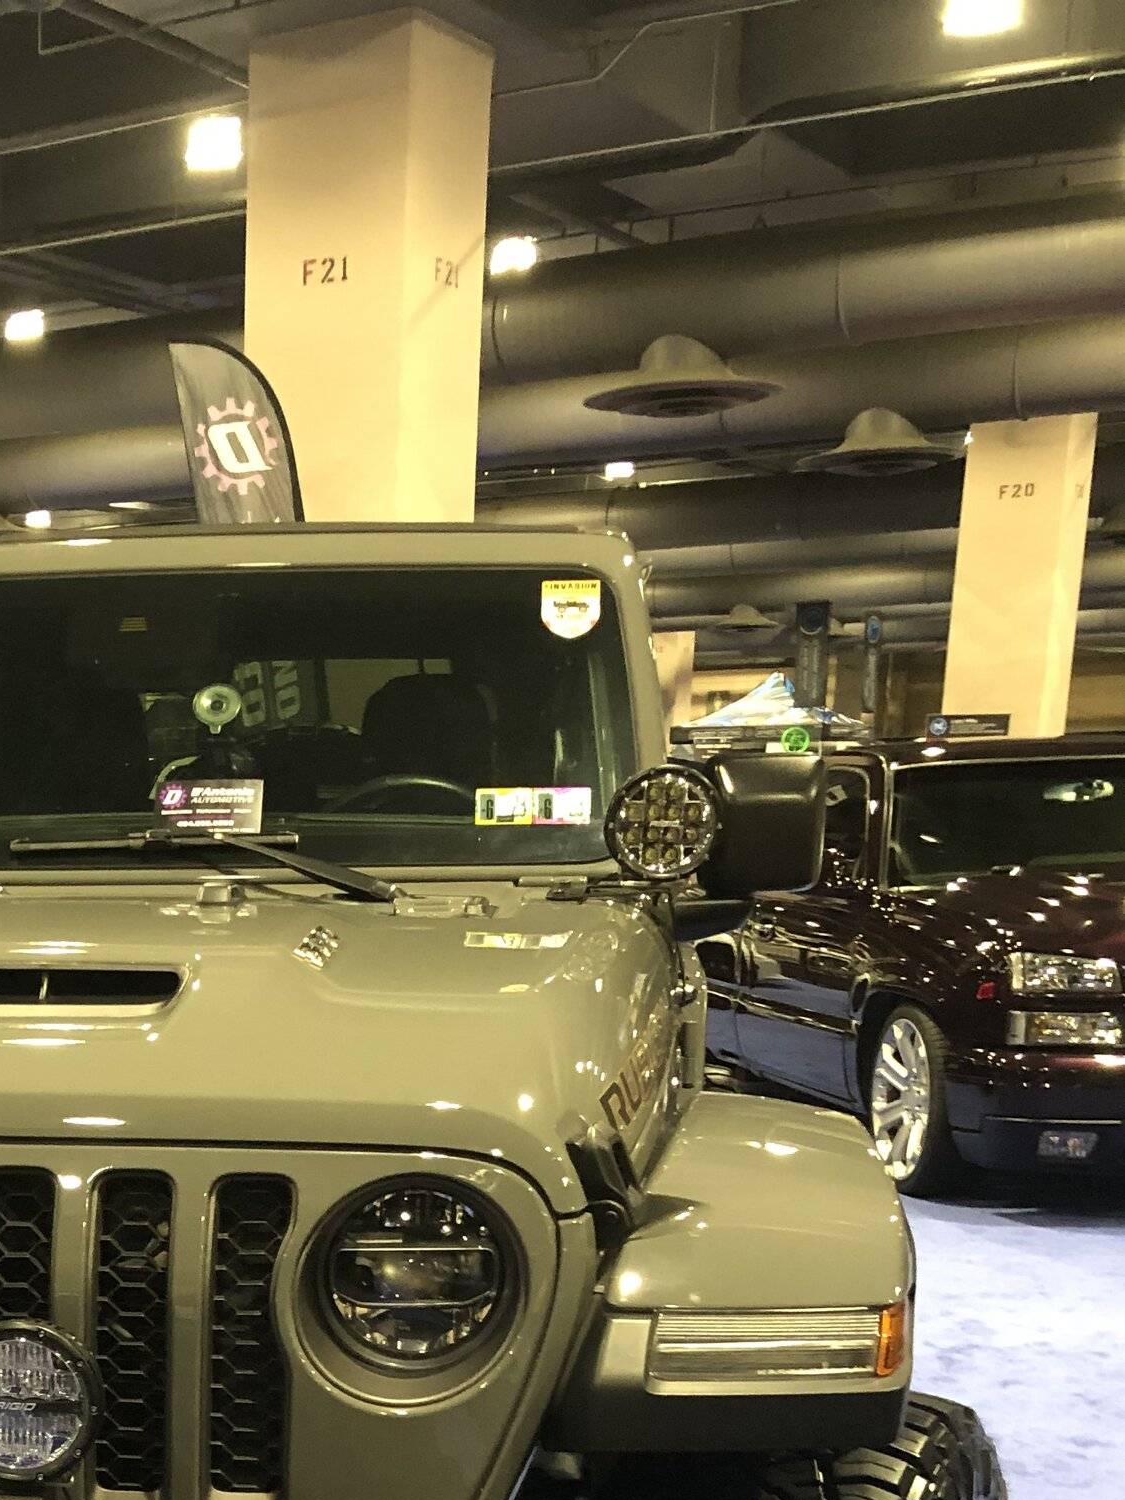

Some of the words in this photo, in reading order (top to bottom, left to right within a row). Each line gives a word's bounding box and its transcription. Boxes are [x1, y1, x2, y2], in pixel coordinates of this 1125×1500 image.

[303, 256, 348, 286] F21
[434, 256, 460, 289] F21
[999, 483, 1035, 500] F20
